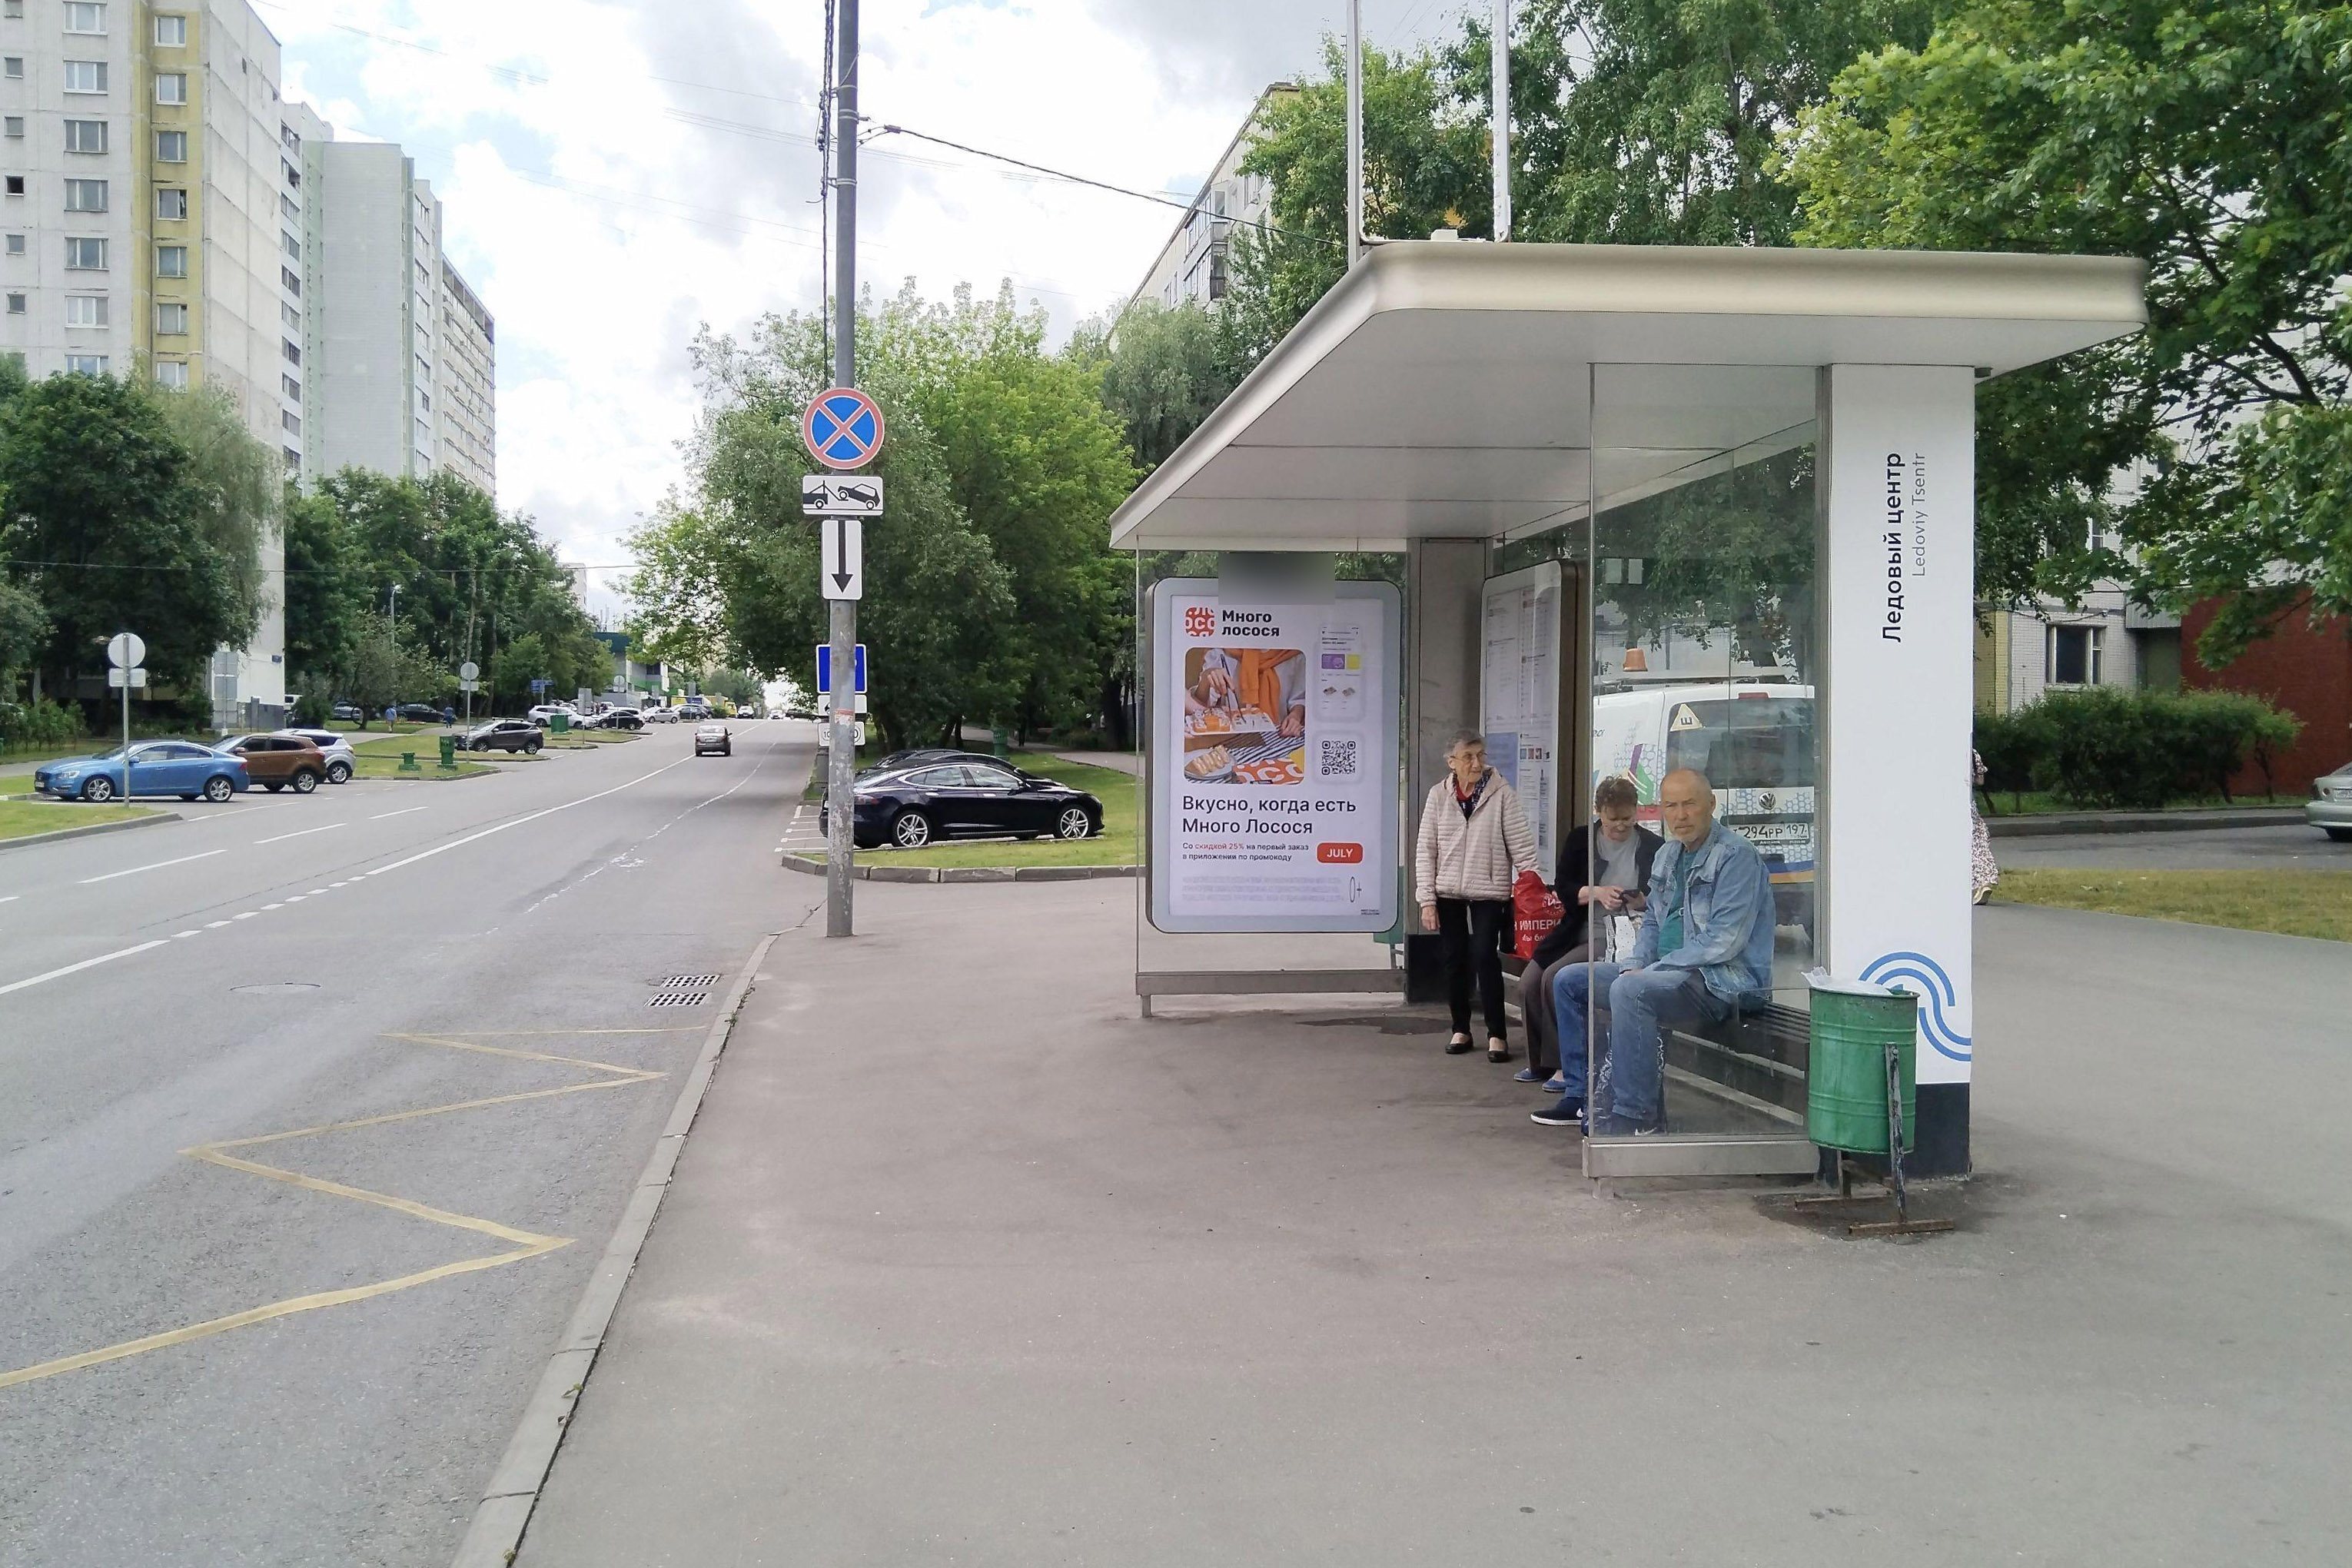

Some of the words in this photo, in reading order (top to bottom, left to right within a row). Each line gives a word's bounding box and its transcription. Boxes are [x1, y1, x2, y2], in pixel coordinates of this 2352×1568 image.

[1912, 452, 1925, 506] Tsentr
[1886, 453, 1905, 524] центр
[1912, 510, 1928, 576] Ledoviy
[1882, 532, 1905, 643] Ледовый
[1222, 610, 1272, 623] Много
[1221, 626, 1280, 636] лосося
[1182, 796, 1254, 814] Вкусно,
[1259, 799, 1310, 814] когда
[1315, 800, 1357, 812] есть
[1182, 818, 1241, 833] Много
[1245, 819, 1313, 834] Лосося
[1257, 843, 1286, 852] первый
[1327, 848, 1354, 858] JULY
